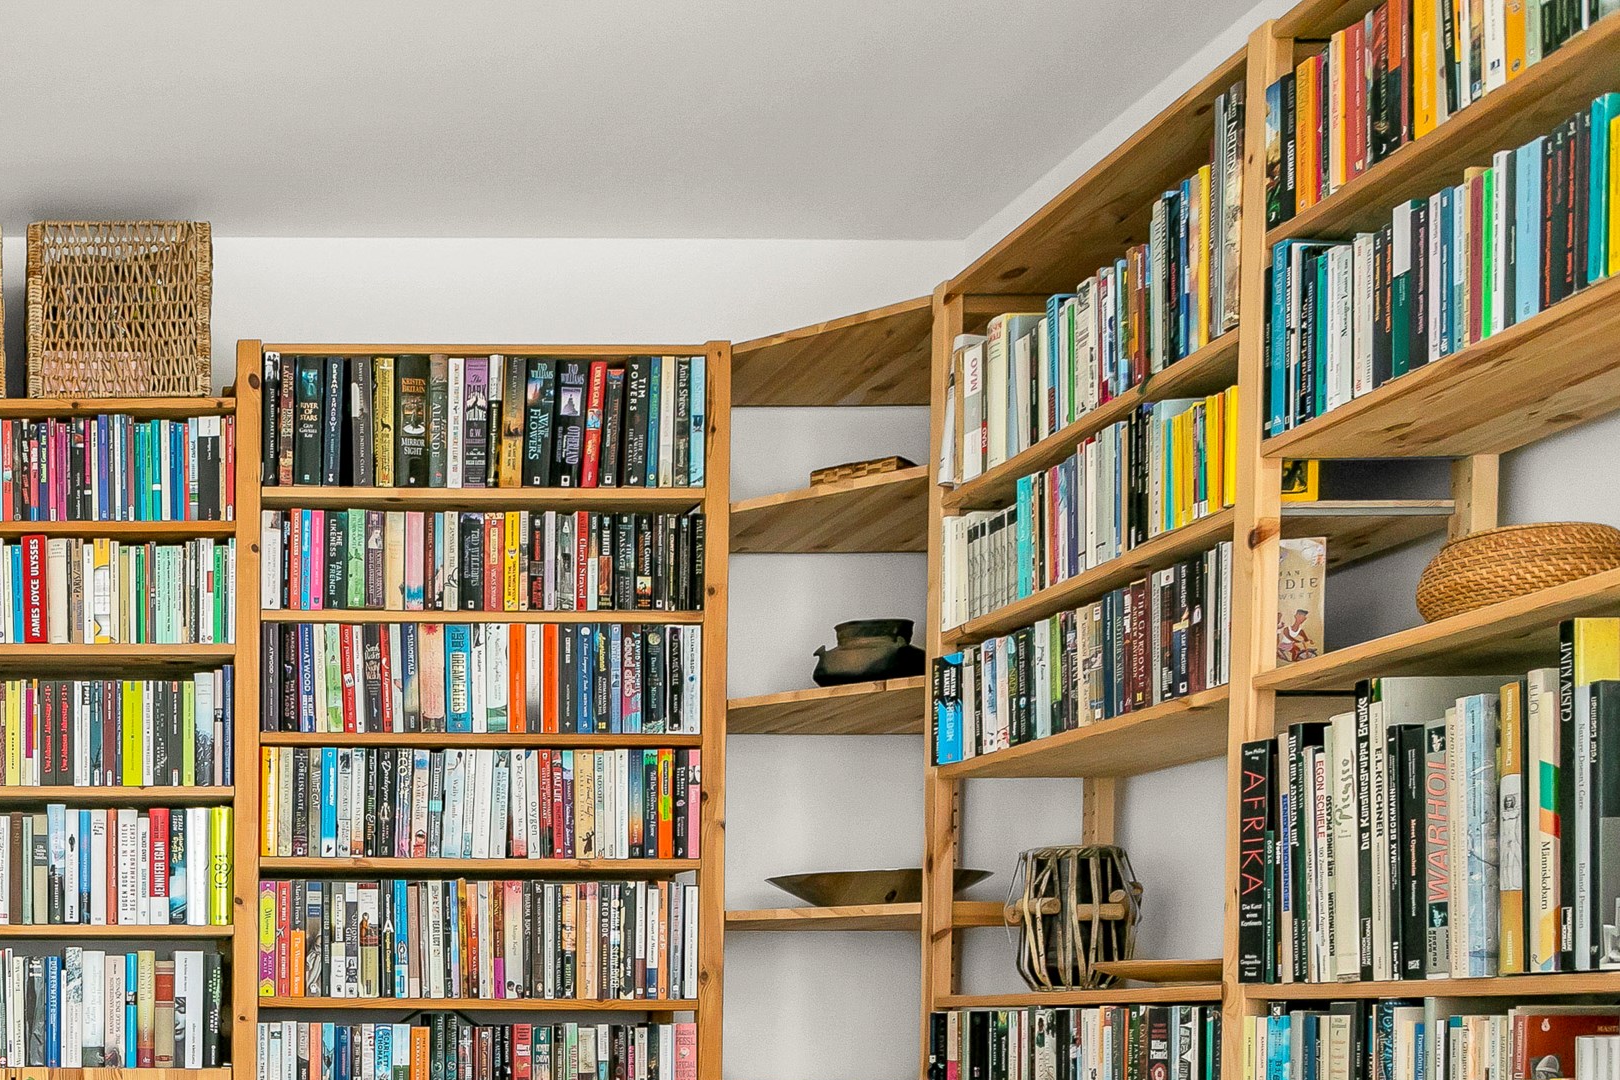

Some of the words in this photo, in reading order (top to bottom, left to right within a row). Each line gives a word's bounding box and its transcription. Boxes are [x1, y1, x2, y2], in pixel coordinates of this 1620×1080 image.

[1287, 140, 1295, 191] LASERMANNEN
[401, 378, 425, 386] KRISTEN
[629, 365, 639, 411] POWERS
[638, 378, 646, 397] TIM
[678, 365, 687, 386] Anita
[970, 357, 979, 392] MAO
[678, 389, 687, 416] Shreve
[401, 438, 425, 447] MIRROR
[432, 403, 441, 457] ALLENDE
[528, 409, 539, 459] FLOWERS
[403, 446, 423, 456] SIGHT
[30, 539, 39, 575] ULYSSES
[31, 579, 39, 605] JOYCE
[579, 568, 587, 598] Strayed
[32, 609, 40, 636] JAMES
[453, 654, 465, 680] DREAM
[453, 684, 466, 712] EATERS
[1561, 680, 1572, 722] GUSTAV
[1316, 760, 1325, 792] EGON
[1578, 754, 1586, 788] Doesn't
[1316, 795, 1326, 838] SCHIELE
[1389, 788, 1397, 840] BECKMANN
[1578, 791, 1586, 810] Care
[530, 802, 538, 836] oxygen
[1243, 770, 1265, 896] AFRIKA
[1427, 753, 1448, 901] WARHOL
[154, 842, 164, 861] EGAN
[154, 862, 165, 896] JENNIFER
[1540, 841, 1550, 910] Människobarn
[1578, 896, 1586, 928] Persson
[1273, 1059, 1283, 1080] Big
